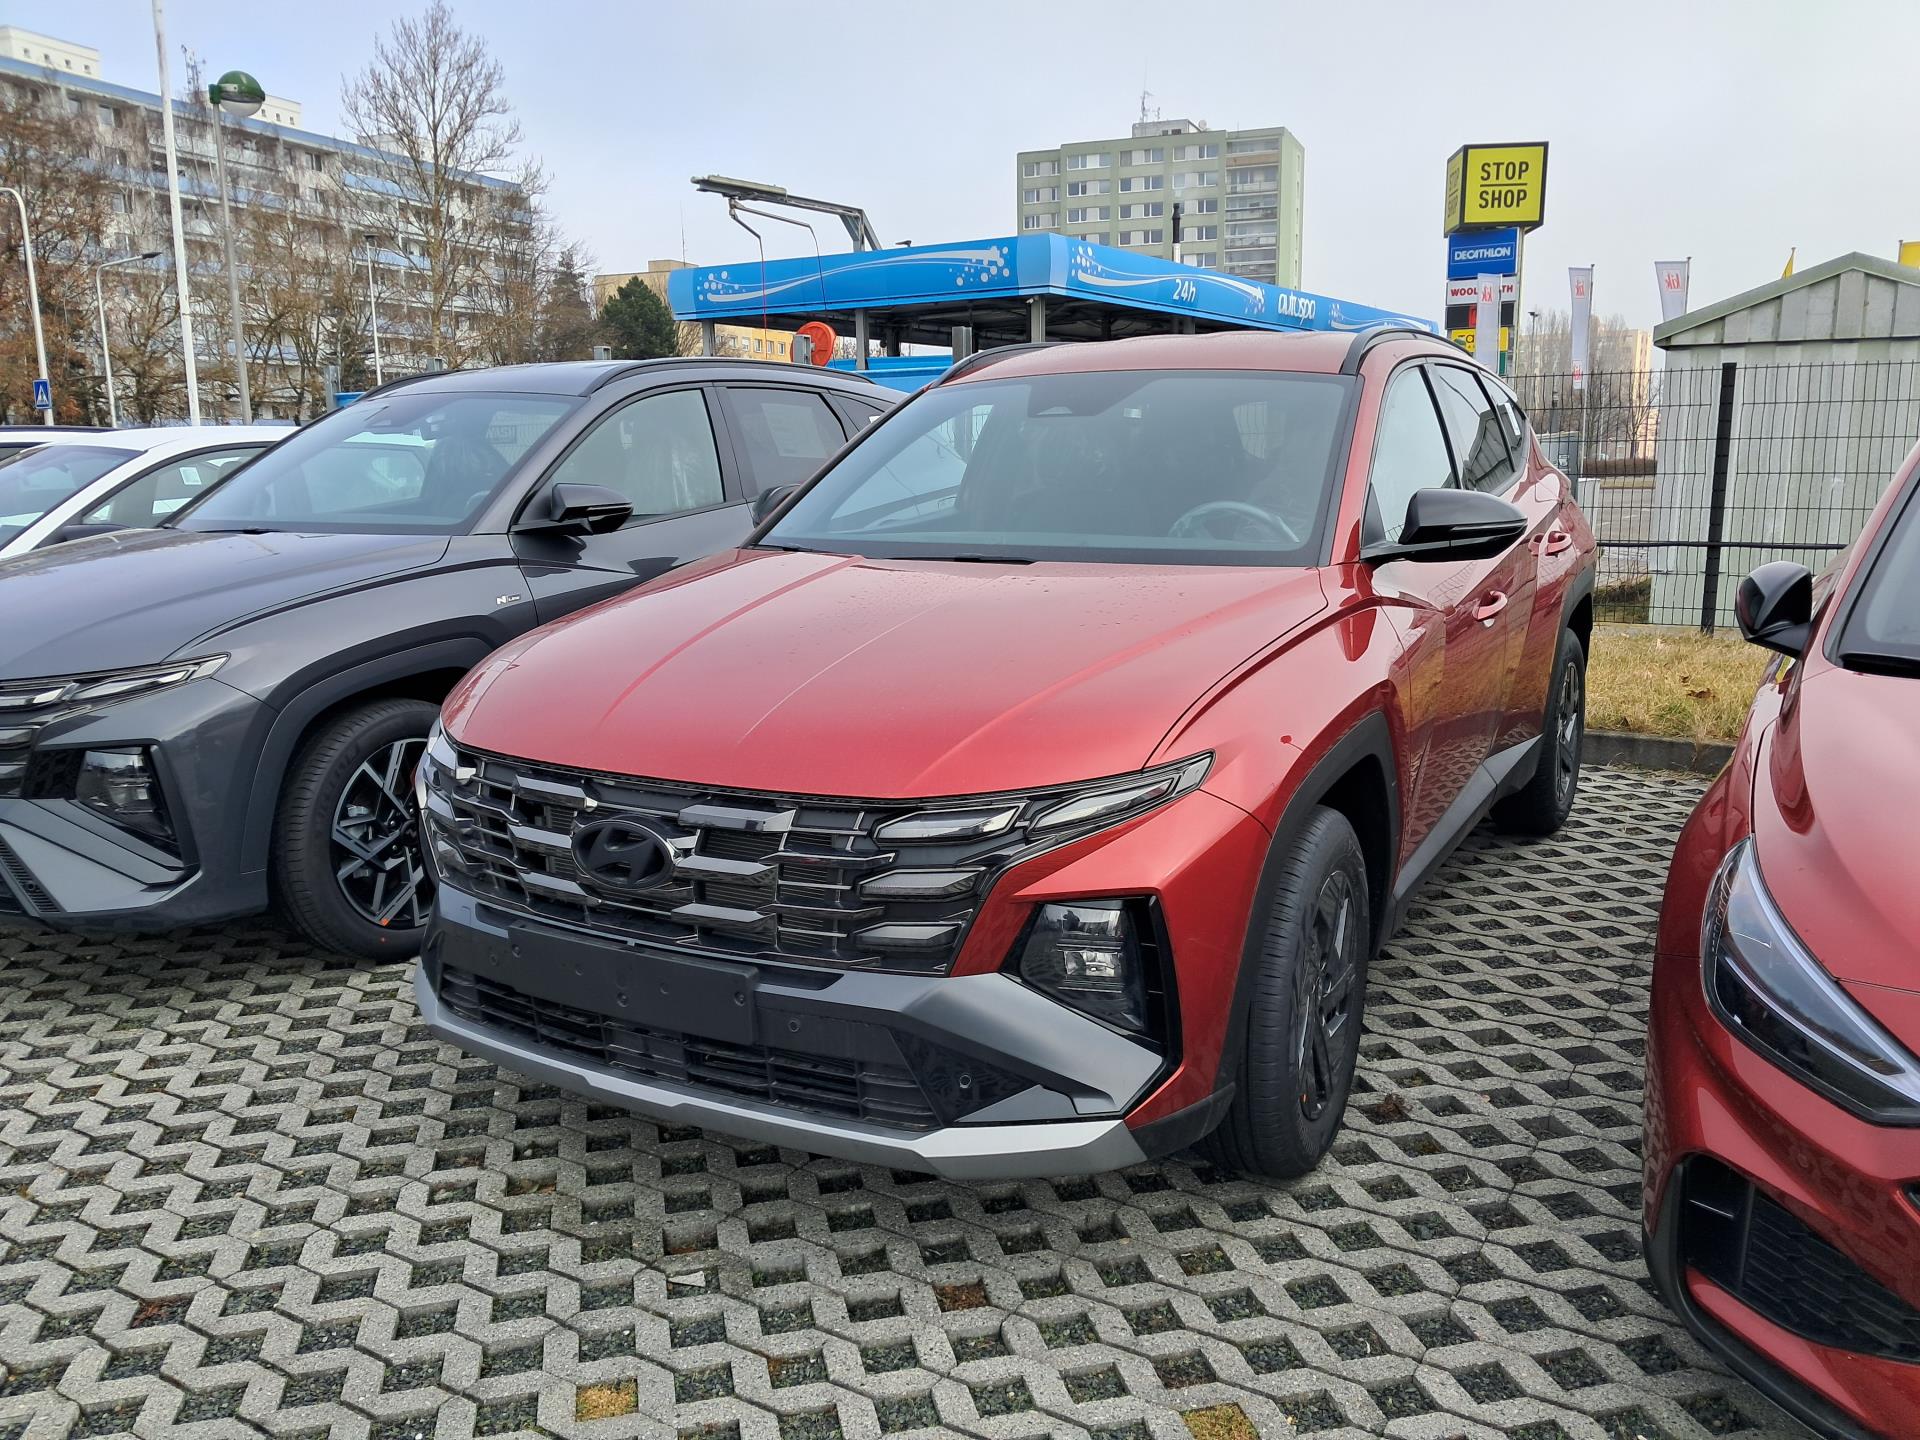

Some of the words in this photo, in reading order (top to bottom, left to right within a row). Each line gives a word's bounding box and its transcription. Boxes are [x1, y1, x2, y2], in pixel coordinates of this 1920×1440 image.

[1481, 161, 1530, 181] STOP
[1479, 189, 1527, 209] SHOP
[1454, 246, 1511, 261] DECATHLON
[1172, 279, 1196, 303] 24h
[1450, 284, 1514, 297] WOOLTH
[1278, 291, 1316, 327] autospa
[496, 595, 506, 605] N
